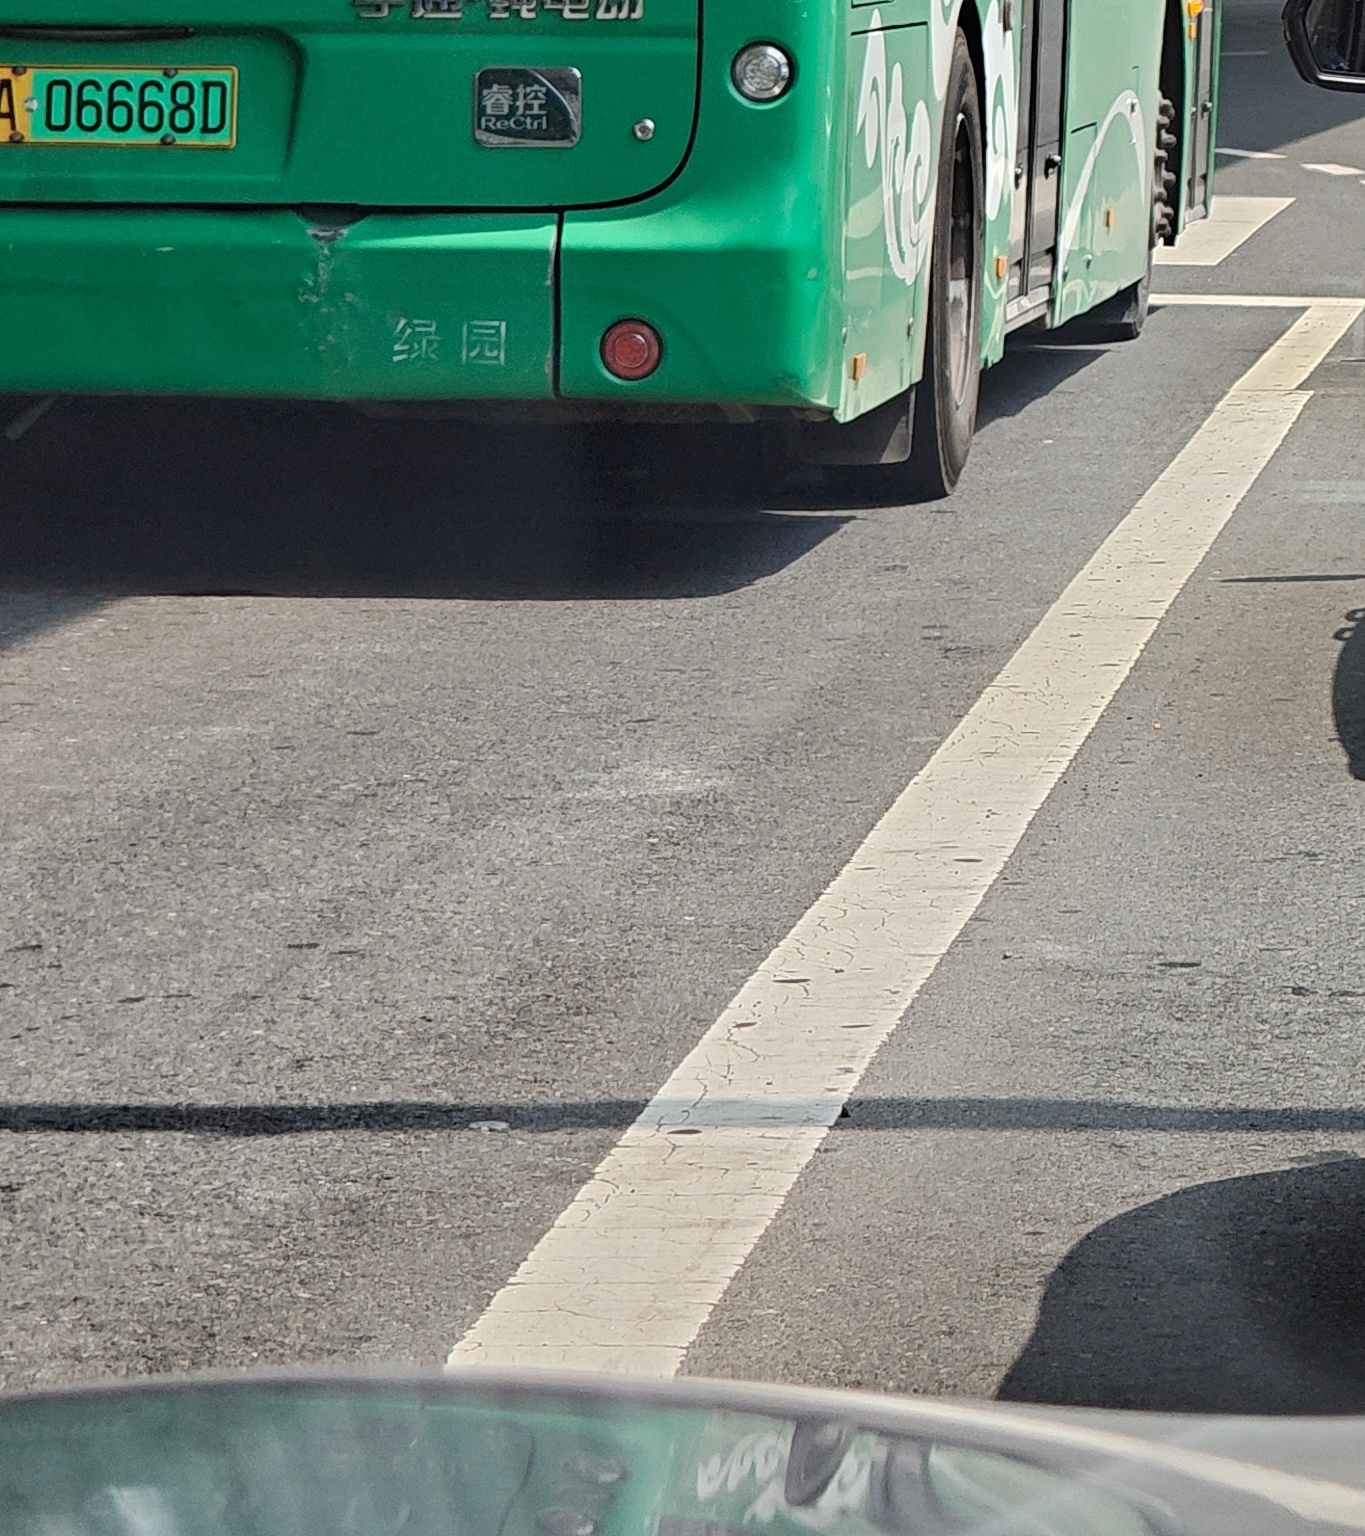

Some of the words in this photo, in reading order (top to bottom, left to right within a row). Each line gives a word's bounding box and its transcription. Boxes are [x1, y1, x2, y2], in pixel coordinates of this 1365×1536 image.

[482, 83, 548, 115] 睿控
[481, 116, 547, 131] ReCtrl
[392, 317, 507, 365] 绿园
